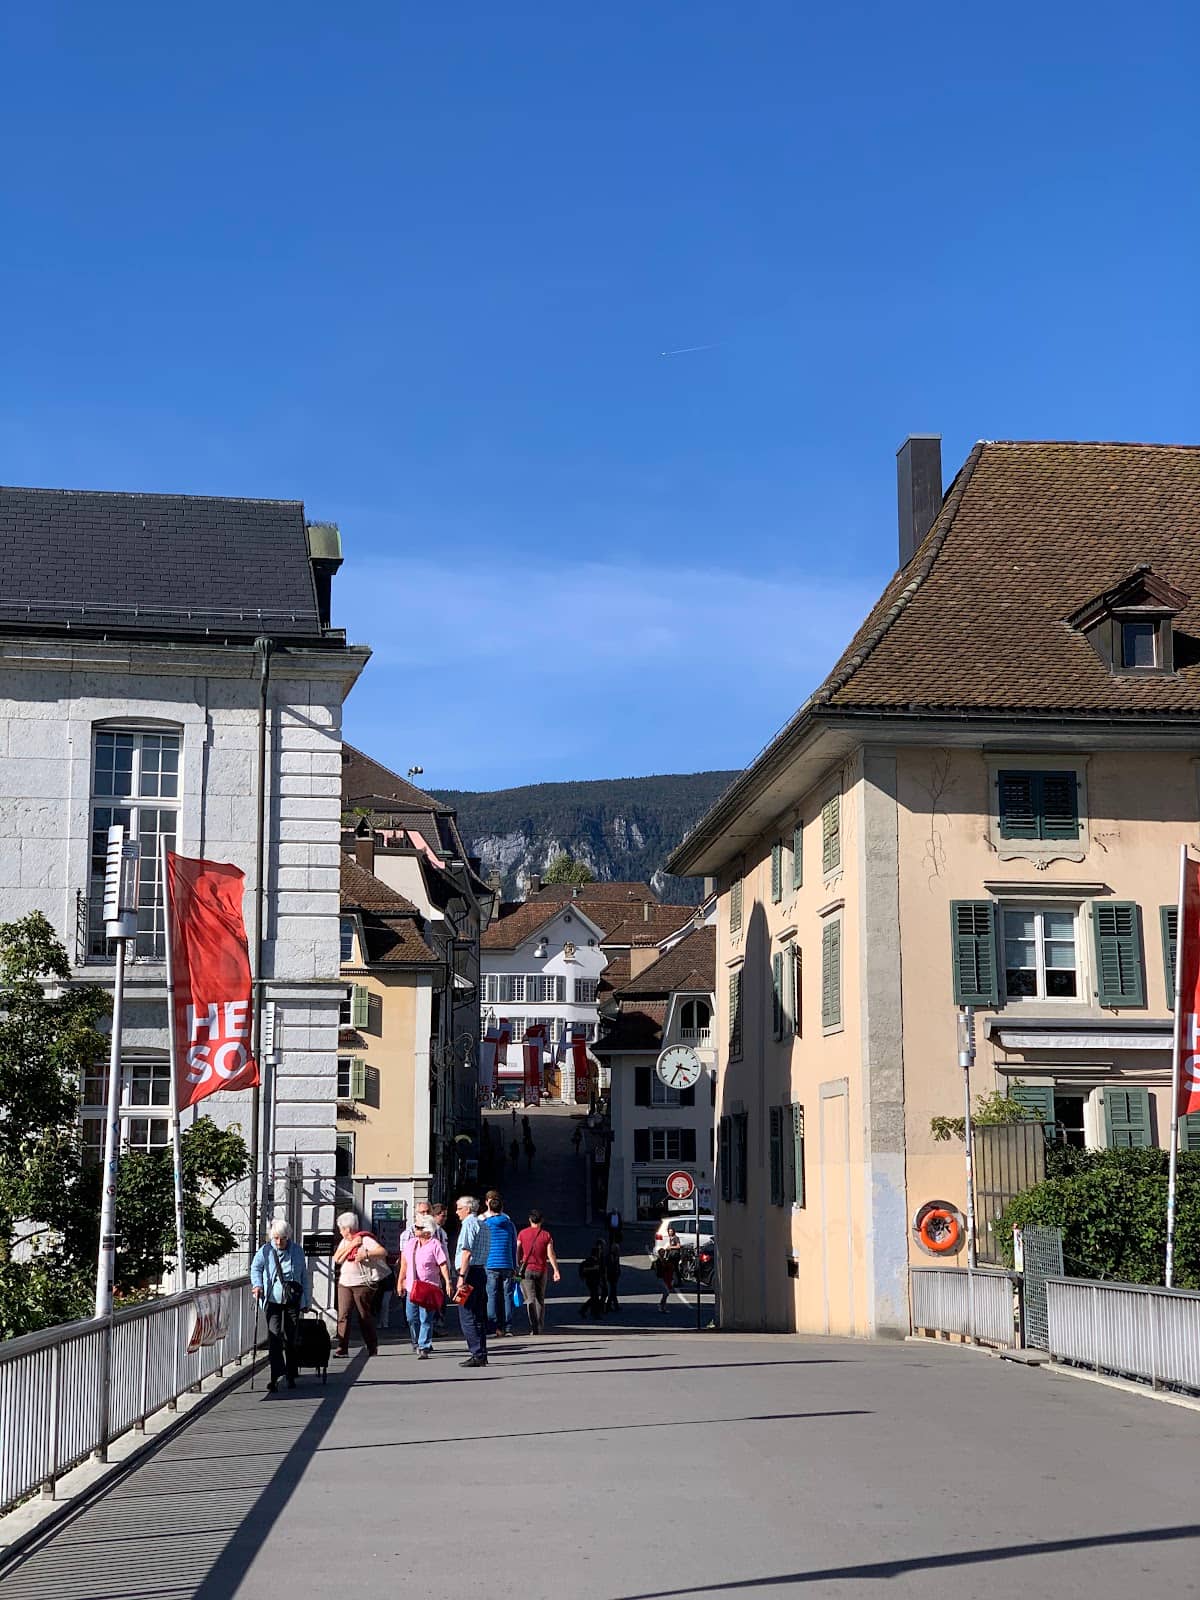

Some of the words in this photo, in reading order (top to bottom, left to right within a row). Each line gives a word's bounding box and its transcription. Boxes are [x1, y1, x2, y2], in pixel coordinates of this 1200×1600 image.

[186, 1001, 249, 1042] HE
[185, 1042, 248, 1084] SO
[576, 1076, 587, 1085] HE
[525, 1085, 539, 1095] HE
[576, 1084, 587, 1093] SO
